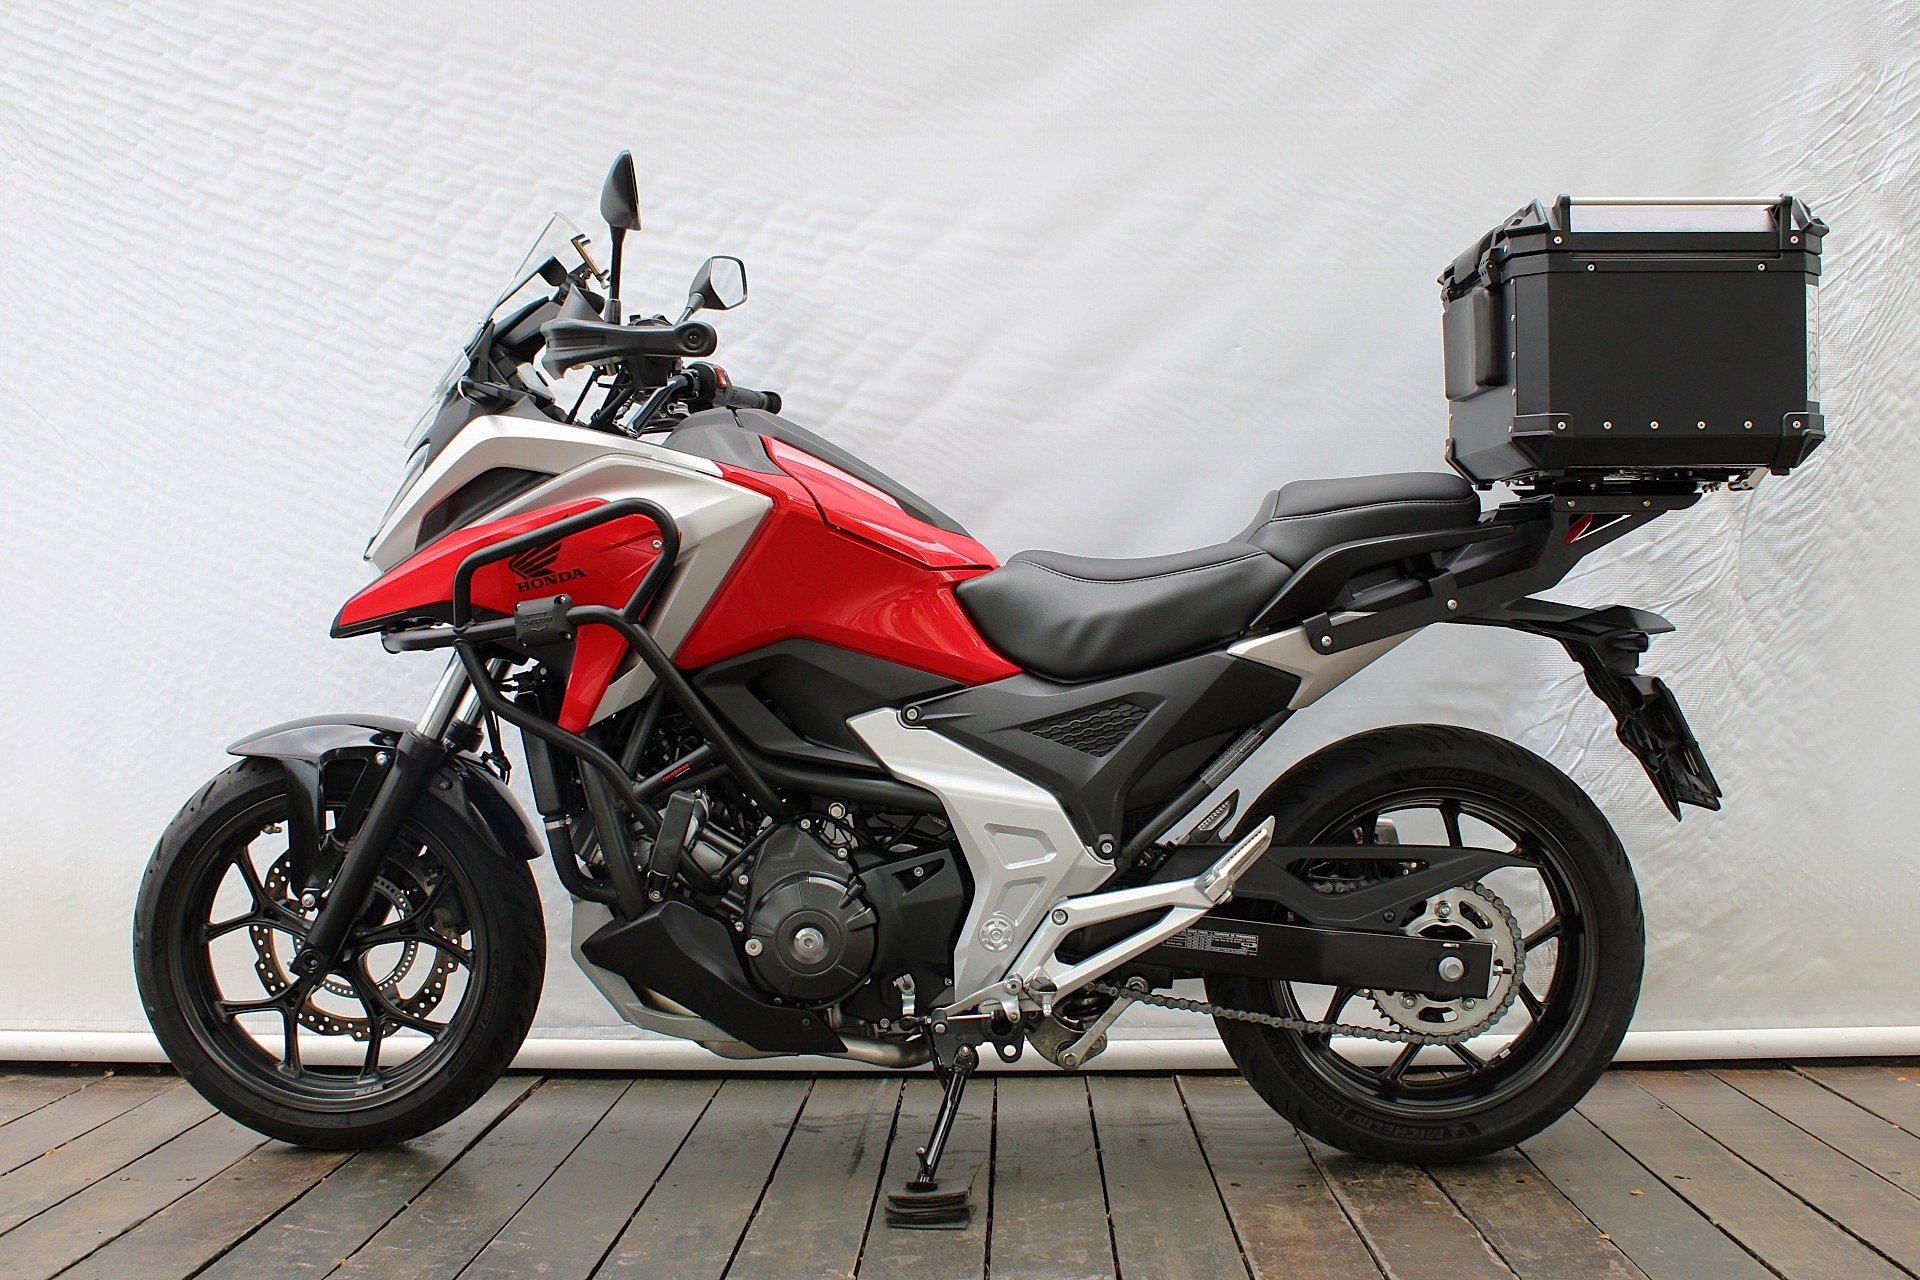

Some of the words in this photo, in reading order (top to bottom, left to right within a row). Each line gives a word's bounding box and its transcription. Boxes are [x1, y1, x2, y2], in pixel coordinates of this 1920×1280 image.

[1808, 295, 1818, 392] ATROX
[515, 568, 587, 593] HONDA
[1295, 1073, 1342, 1113] 160/60
[1352, 1113, 1445, 1139] MICHELIN
